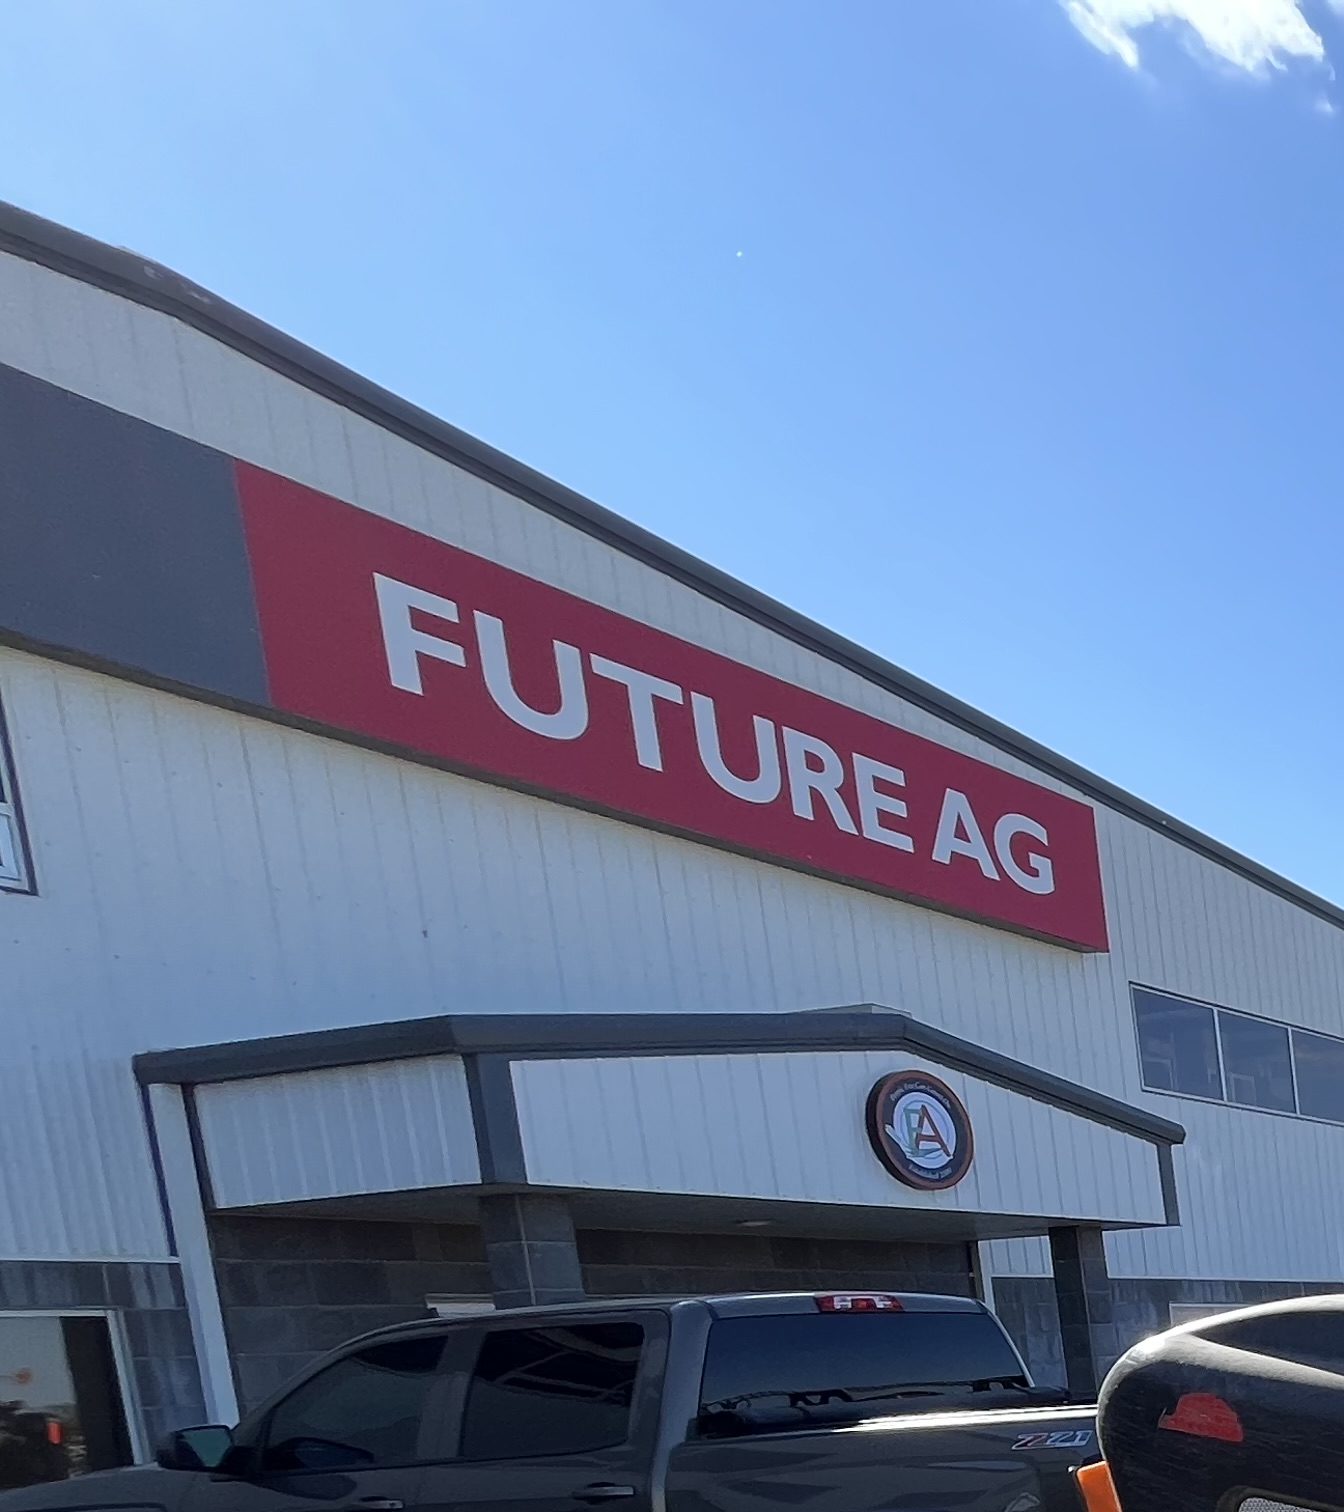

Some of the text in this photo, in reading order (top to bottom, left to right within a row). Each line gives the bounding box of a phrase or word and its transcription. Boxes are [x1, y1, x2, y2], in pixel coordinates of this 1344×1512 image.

[373, 572, 1055, 895] FUTURE AG
[1011, 1430, 1093, 1450] Z71
